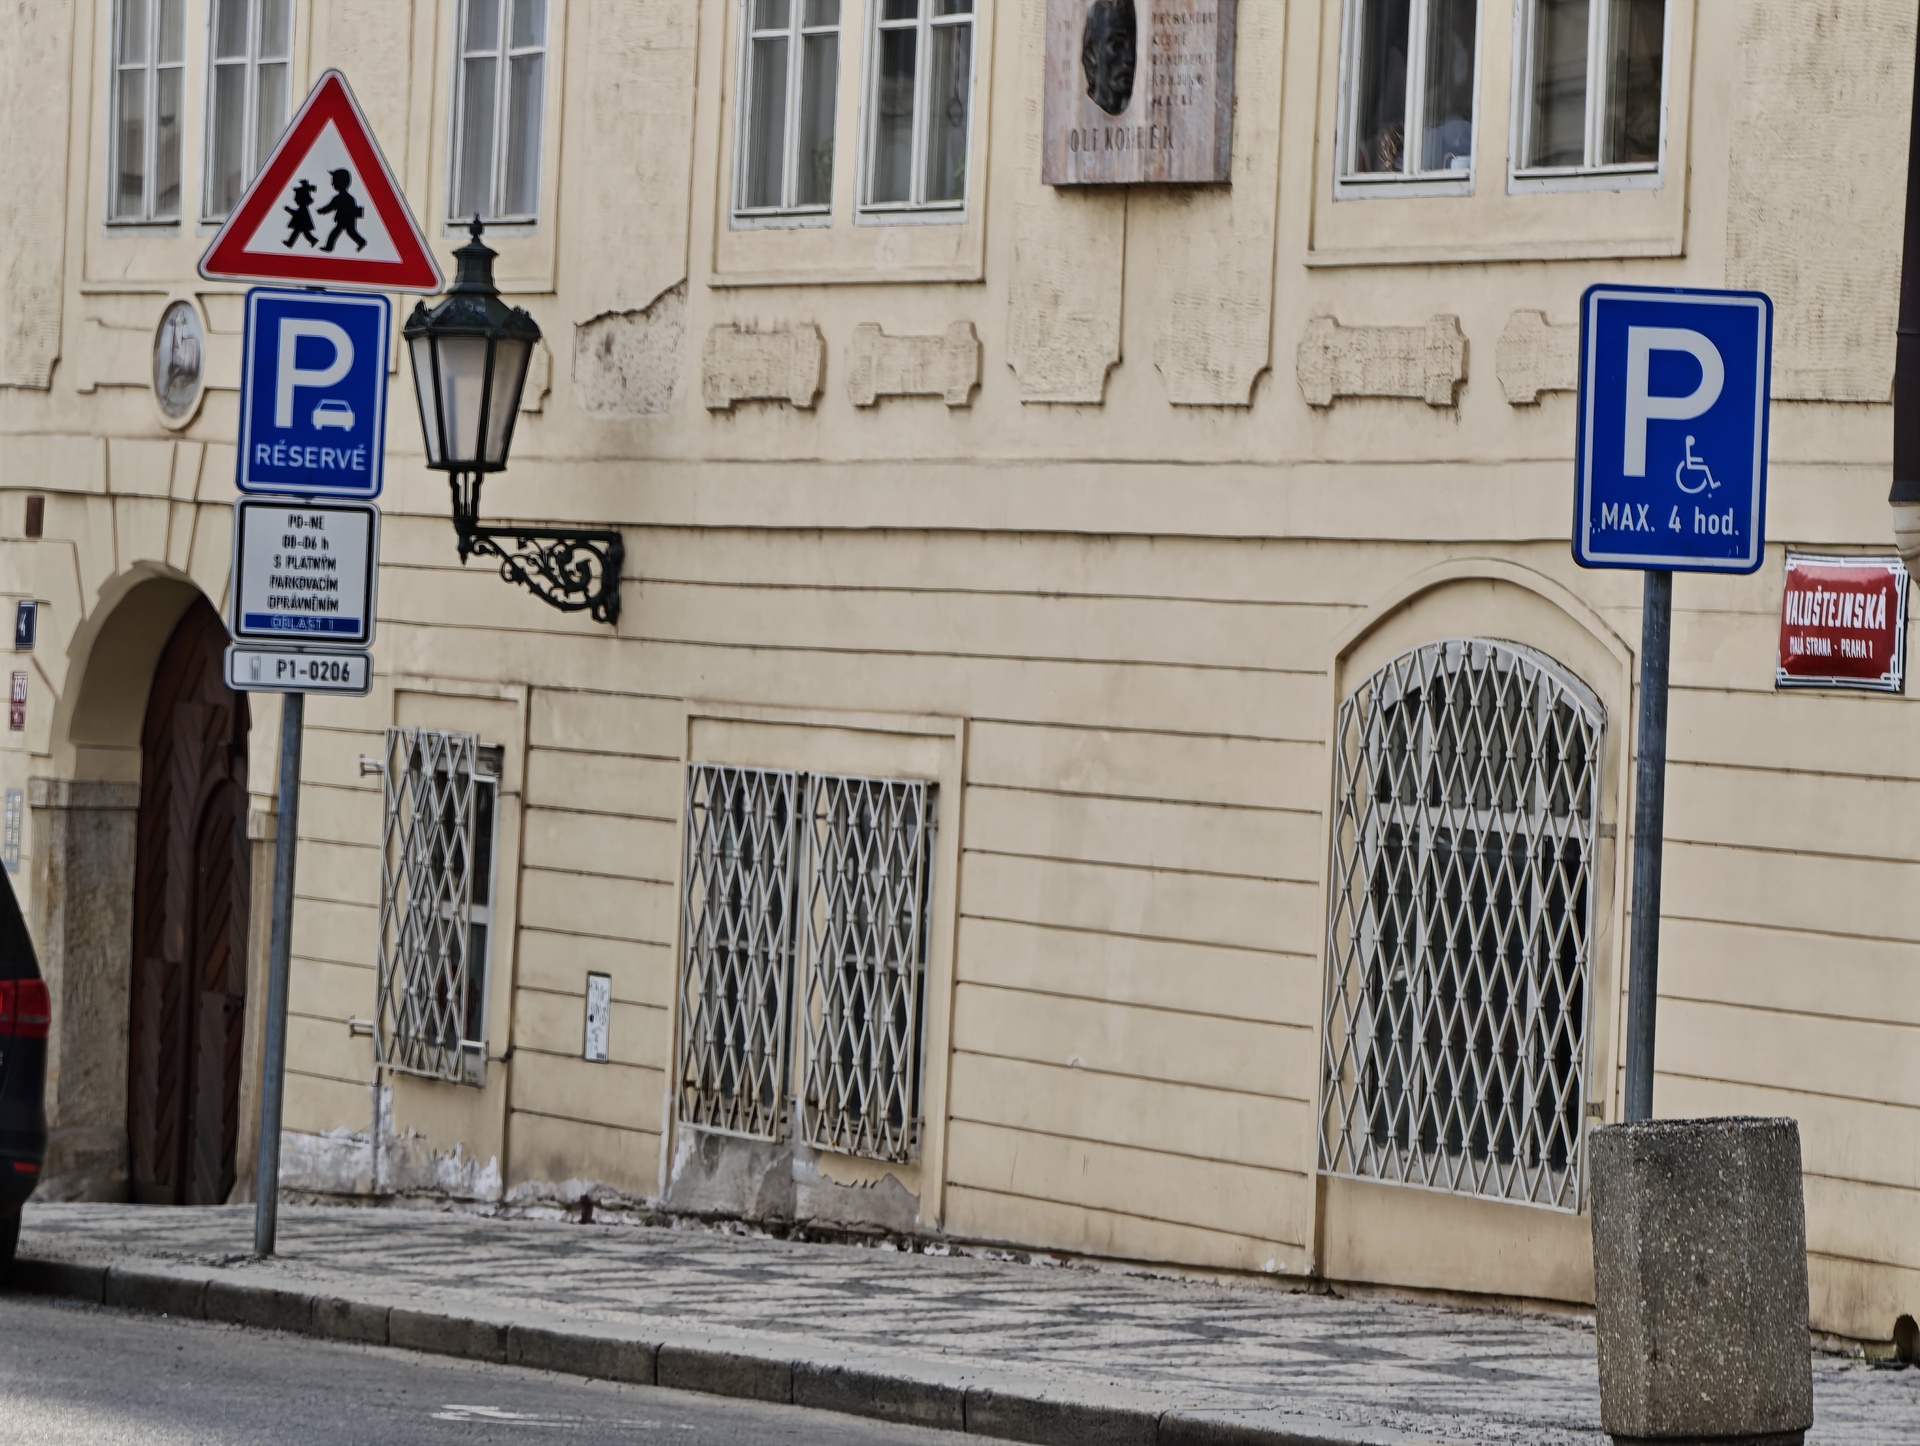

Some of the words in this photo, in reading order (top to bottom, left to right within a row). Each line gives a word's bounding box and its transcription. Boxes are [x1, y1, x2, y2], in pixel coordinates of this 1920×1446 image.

[274, 317, 355, 428] P
[1623, 325, 1725, 477] P
[254, 439, 367, 471] RÉSERVÉ
[1601, 502, 1656, 533] MAX.
[1668, 505, 1682, 533] 4
[1694, 506, 1740, 536] hod.
[272, 554, 282, 569] S
[286, 554, 337, 572] PLATNÝM
[269, 574, 338, 592] PARKOVACÍM
[267, 593, 339, 613] OPRÁVNĚNÍM
[1786, 585, 1886, 630] VALDŠTEJNSKÁ
[270, 615, 323, 632] OBLAST
[1806, 636, 1832, 657] STRANA
[1841, 638, 1867, 659] PRAHA
[1868, 640, 1873, 659] 1
[275, 658, 351, 683] P1-0206
